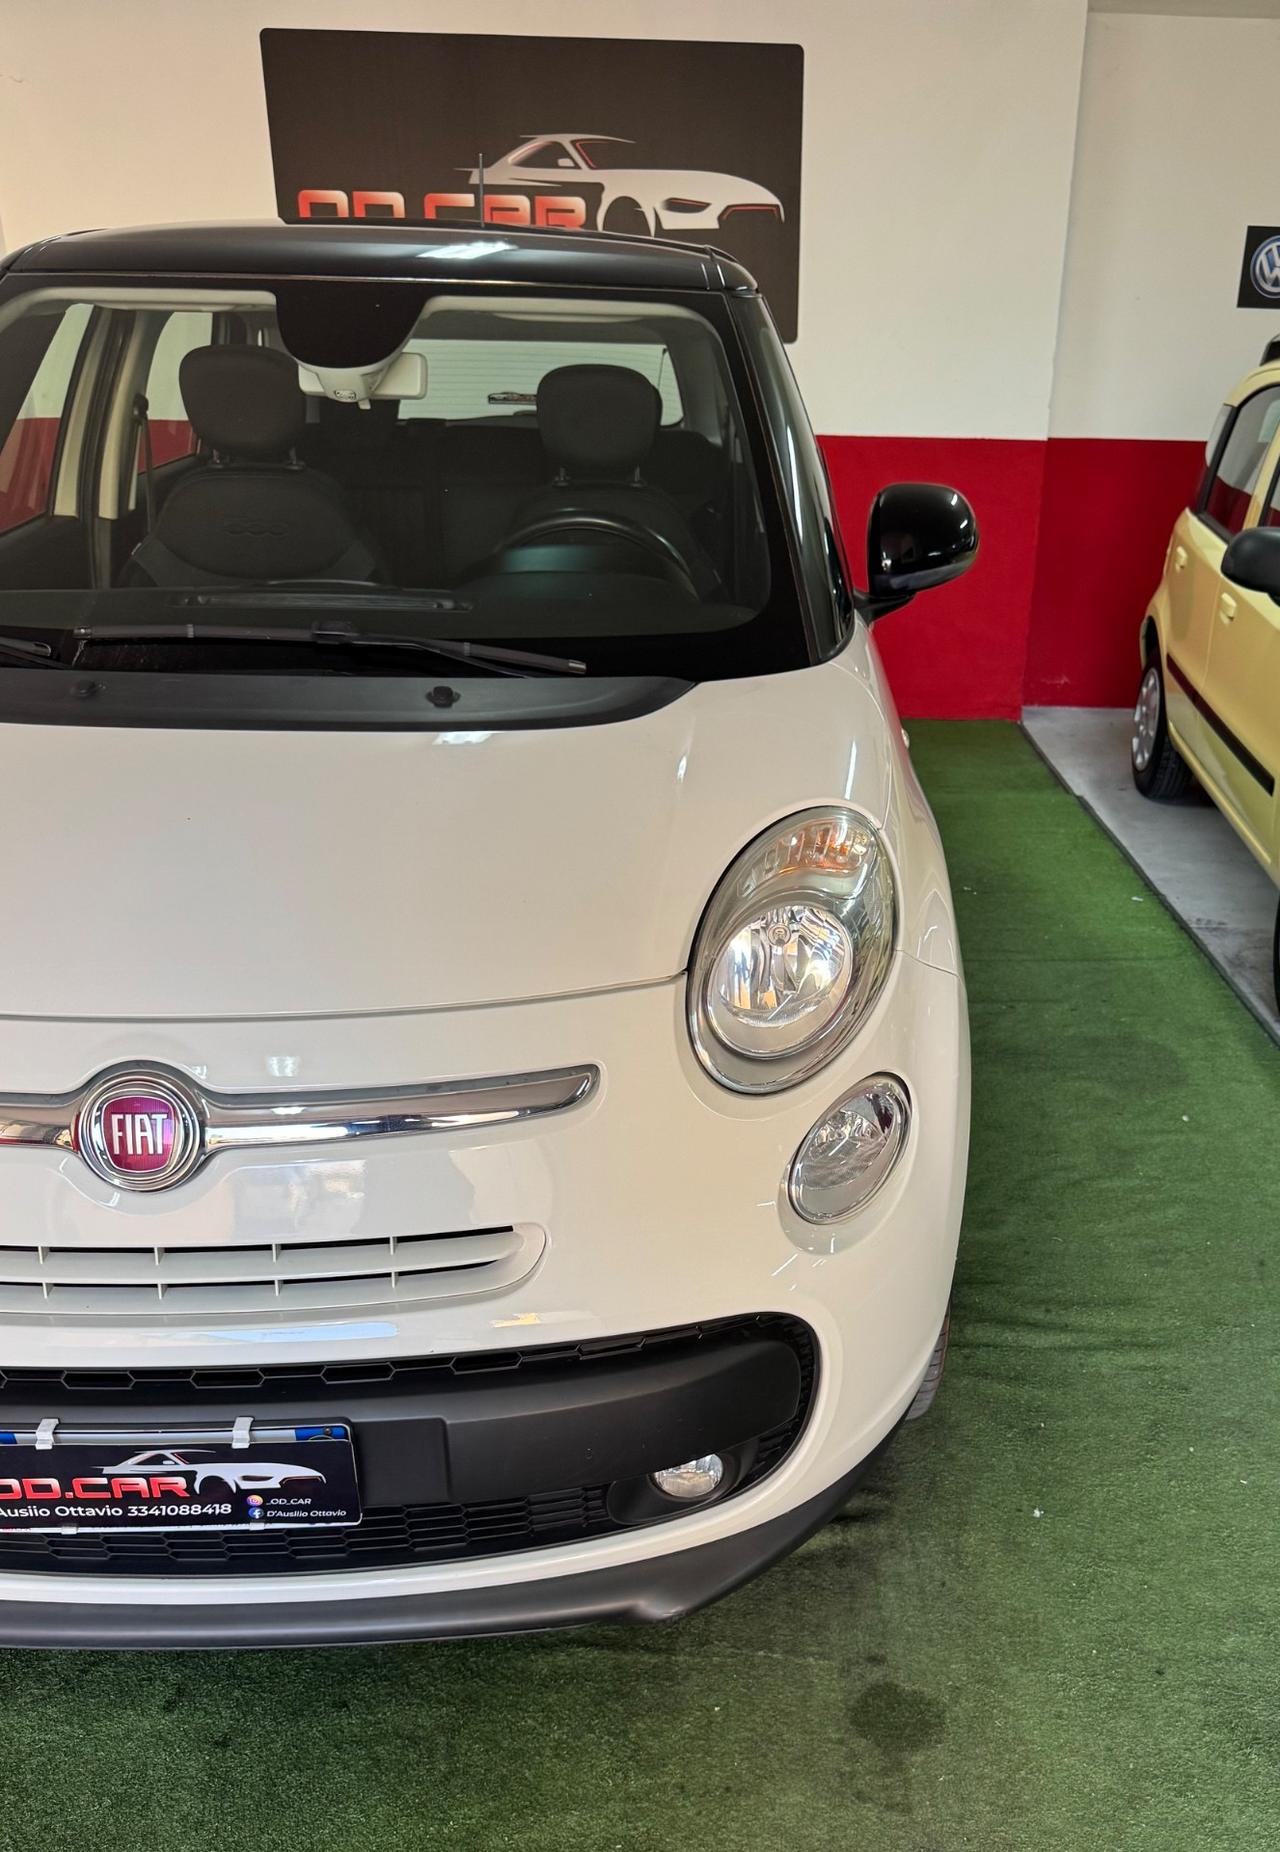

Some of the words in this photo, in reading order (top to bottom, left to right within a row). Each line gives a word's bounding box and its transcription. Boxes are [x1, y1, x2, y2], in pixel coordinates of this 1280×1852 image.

[111, 1113, 168, 1155] FIAT
[55, 1505, 122, 1517] Ottavio
[127, 1503, 232, 1517] 3341088418
[310, 1509, 347, 1517] Ottavio
